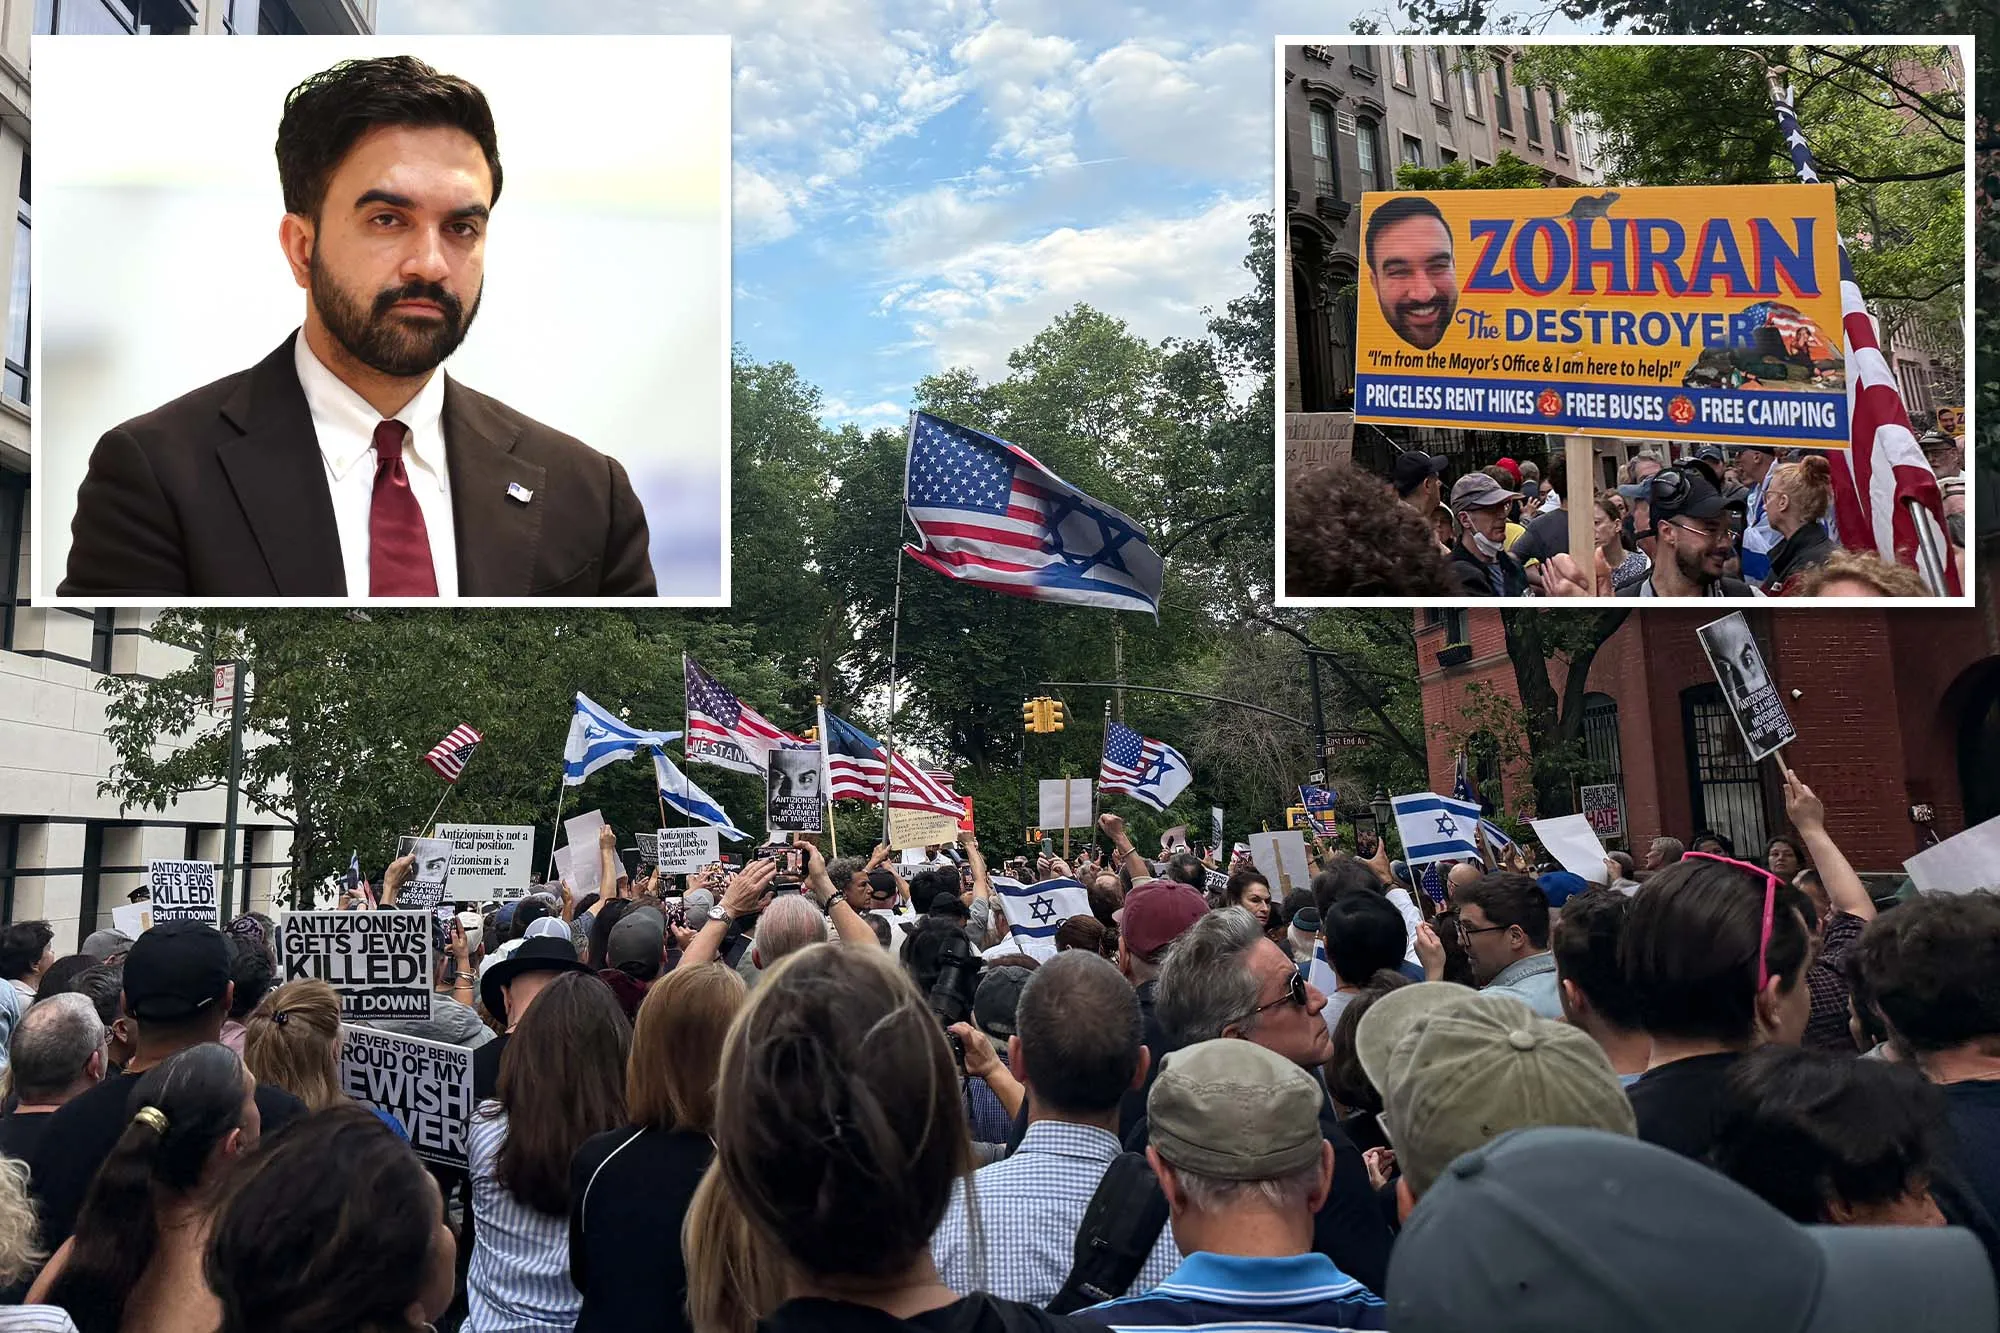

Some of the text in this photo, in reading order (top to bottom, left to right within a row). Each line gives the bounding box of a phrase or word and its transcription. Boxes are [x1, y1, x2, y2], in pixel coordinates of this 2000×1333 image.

[1462, 217, 1822, 299] ZOHRAN
[1456, 308, 1757, 349] The DESTROYER
[1395, 351, 1424, 369] from
[1427, 352, 1447, 369] the
[1450, 353, 1499, 374] Mayor’s
[1502, 354, 1539, 372] Office
[1543, 356, 1552, 372] &
[1556, 357, 1560, 373] I
[1563, 360, 1583, 374] am
[1587, 357, 1617, 375] here
[1620, 361, 1635, 377] to
[1366, 384, 1836, 428] PRICELESS RENT HIKES FREE BUSES FREE CAMPING
[1740, 684, 1774, 711] ANTIZIONISM
[1752, 694, 1778, 715] IS A HATE
[1752, 704, 1782, 728] MOVEMENT
[1749, 714, 1788, 742] THAT TARGETS
[1776, 723, 1792, 739] JEWS
[1343, 737, 1355, 745] End
[1585, 808, 1618, 827] HATE
[440, 829, 493, 840] Antizionism
[497, 830, 504, 840] is
[507, 830, 520, 840] not
[660, 830, 697, 840] Antizionists
[477, 840, 514, 851] position.
[660, 839, 682, 850] spread
[660, 849, 677, 858] mark
[678, 848, 695, 856] Jews
[152, 862, 213, 874] ANTIZIONISM
[494, 855, 501, 866] is
[503, 858, 509, 866] a
[660, 857, 687, 866] violence
[152, 873, 213, 886] GETS JEWS
[458, 867, 506, 876] movement.
[403, 881, 444, 889] NTIZIONISM
[153, 886, 214, 904] KILLED!
[402, 892, 440, 900] MOVEMENT
[154, 910, 216, 921] SHUT IT DOWN!
[285, 915, 426, 933] ANTIZIONISM
[285, 934, 426, 954] GETS JEWS
[286, 955, 427, 985] KILLED!
[342, 995, 427, 1011] IT DOWN!
[350, 1031, 467, 1066] NEVER STOP BEING
[341, 1042, 467, 1084] ROUD OF MY
[343, 1062, 469, 1120] EWISH
